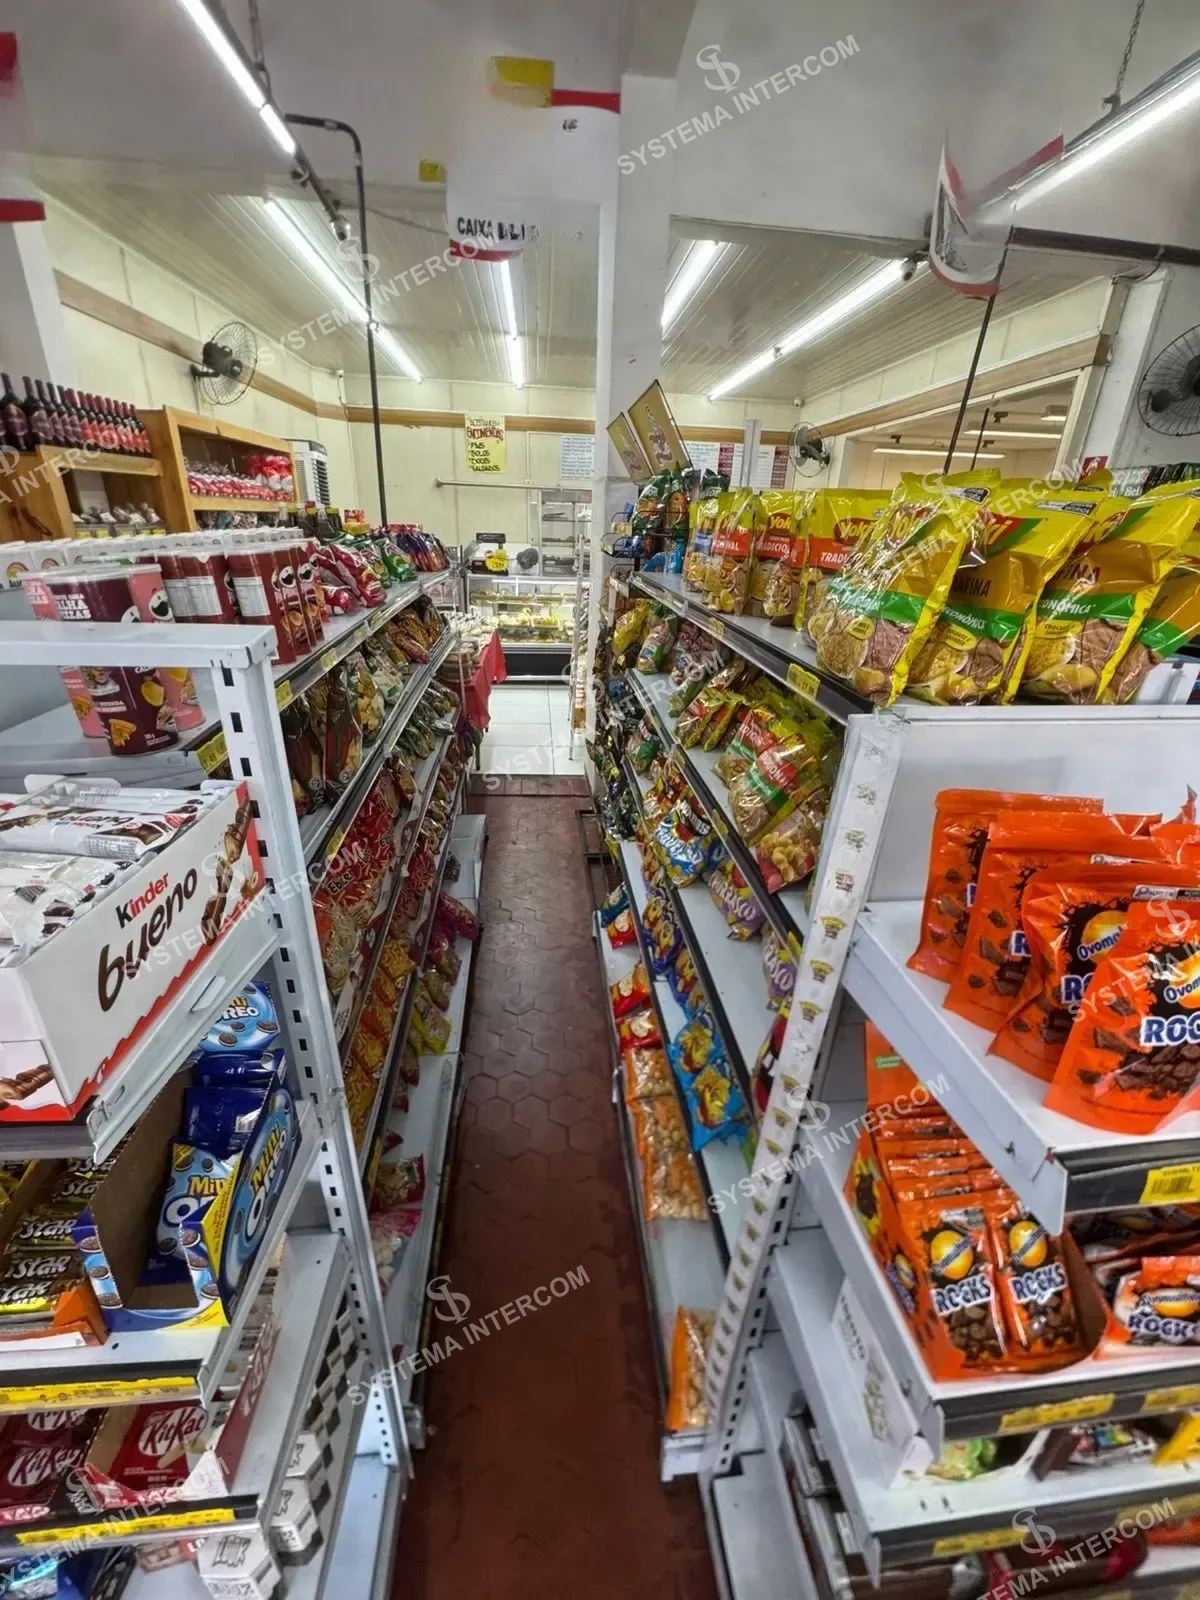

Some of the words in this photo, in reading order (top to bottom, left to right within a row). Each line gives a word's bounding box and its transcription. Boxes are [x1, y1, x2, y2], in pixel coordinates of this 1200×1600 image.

[115, 871, 169, 929] Kinder
[98, 867, 198, 1013] bueno
[143, 1407, 205, 1455] KitKat
